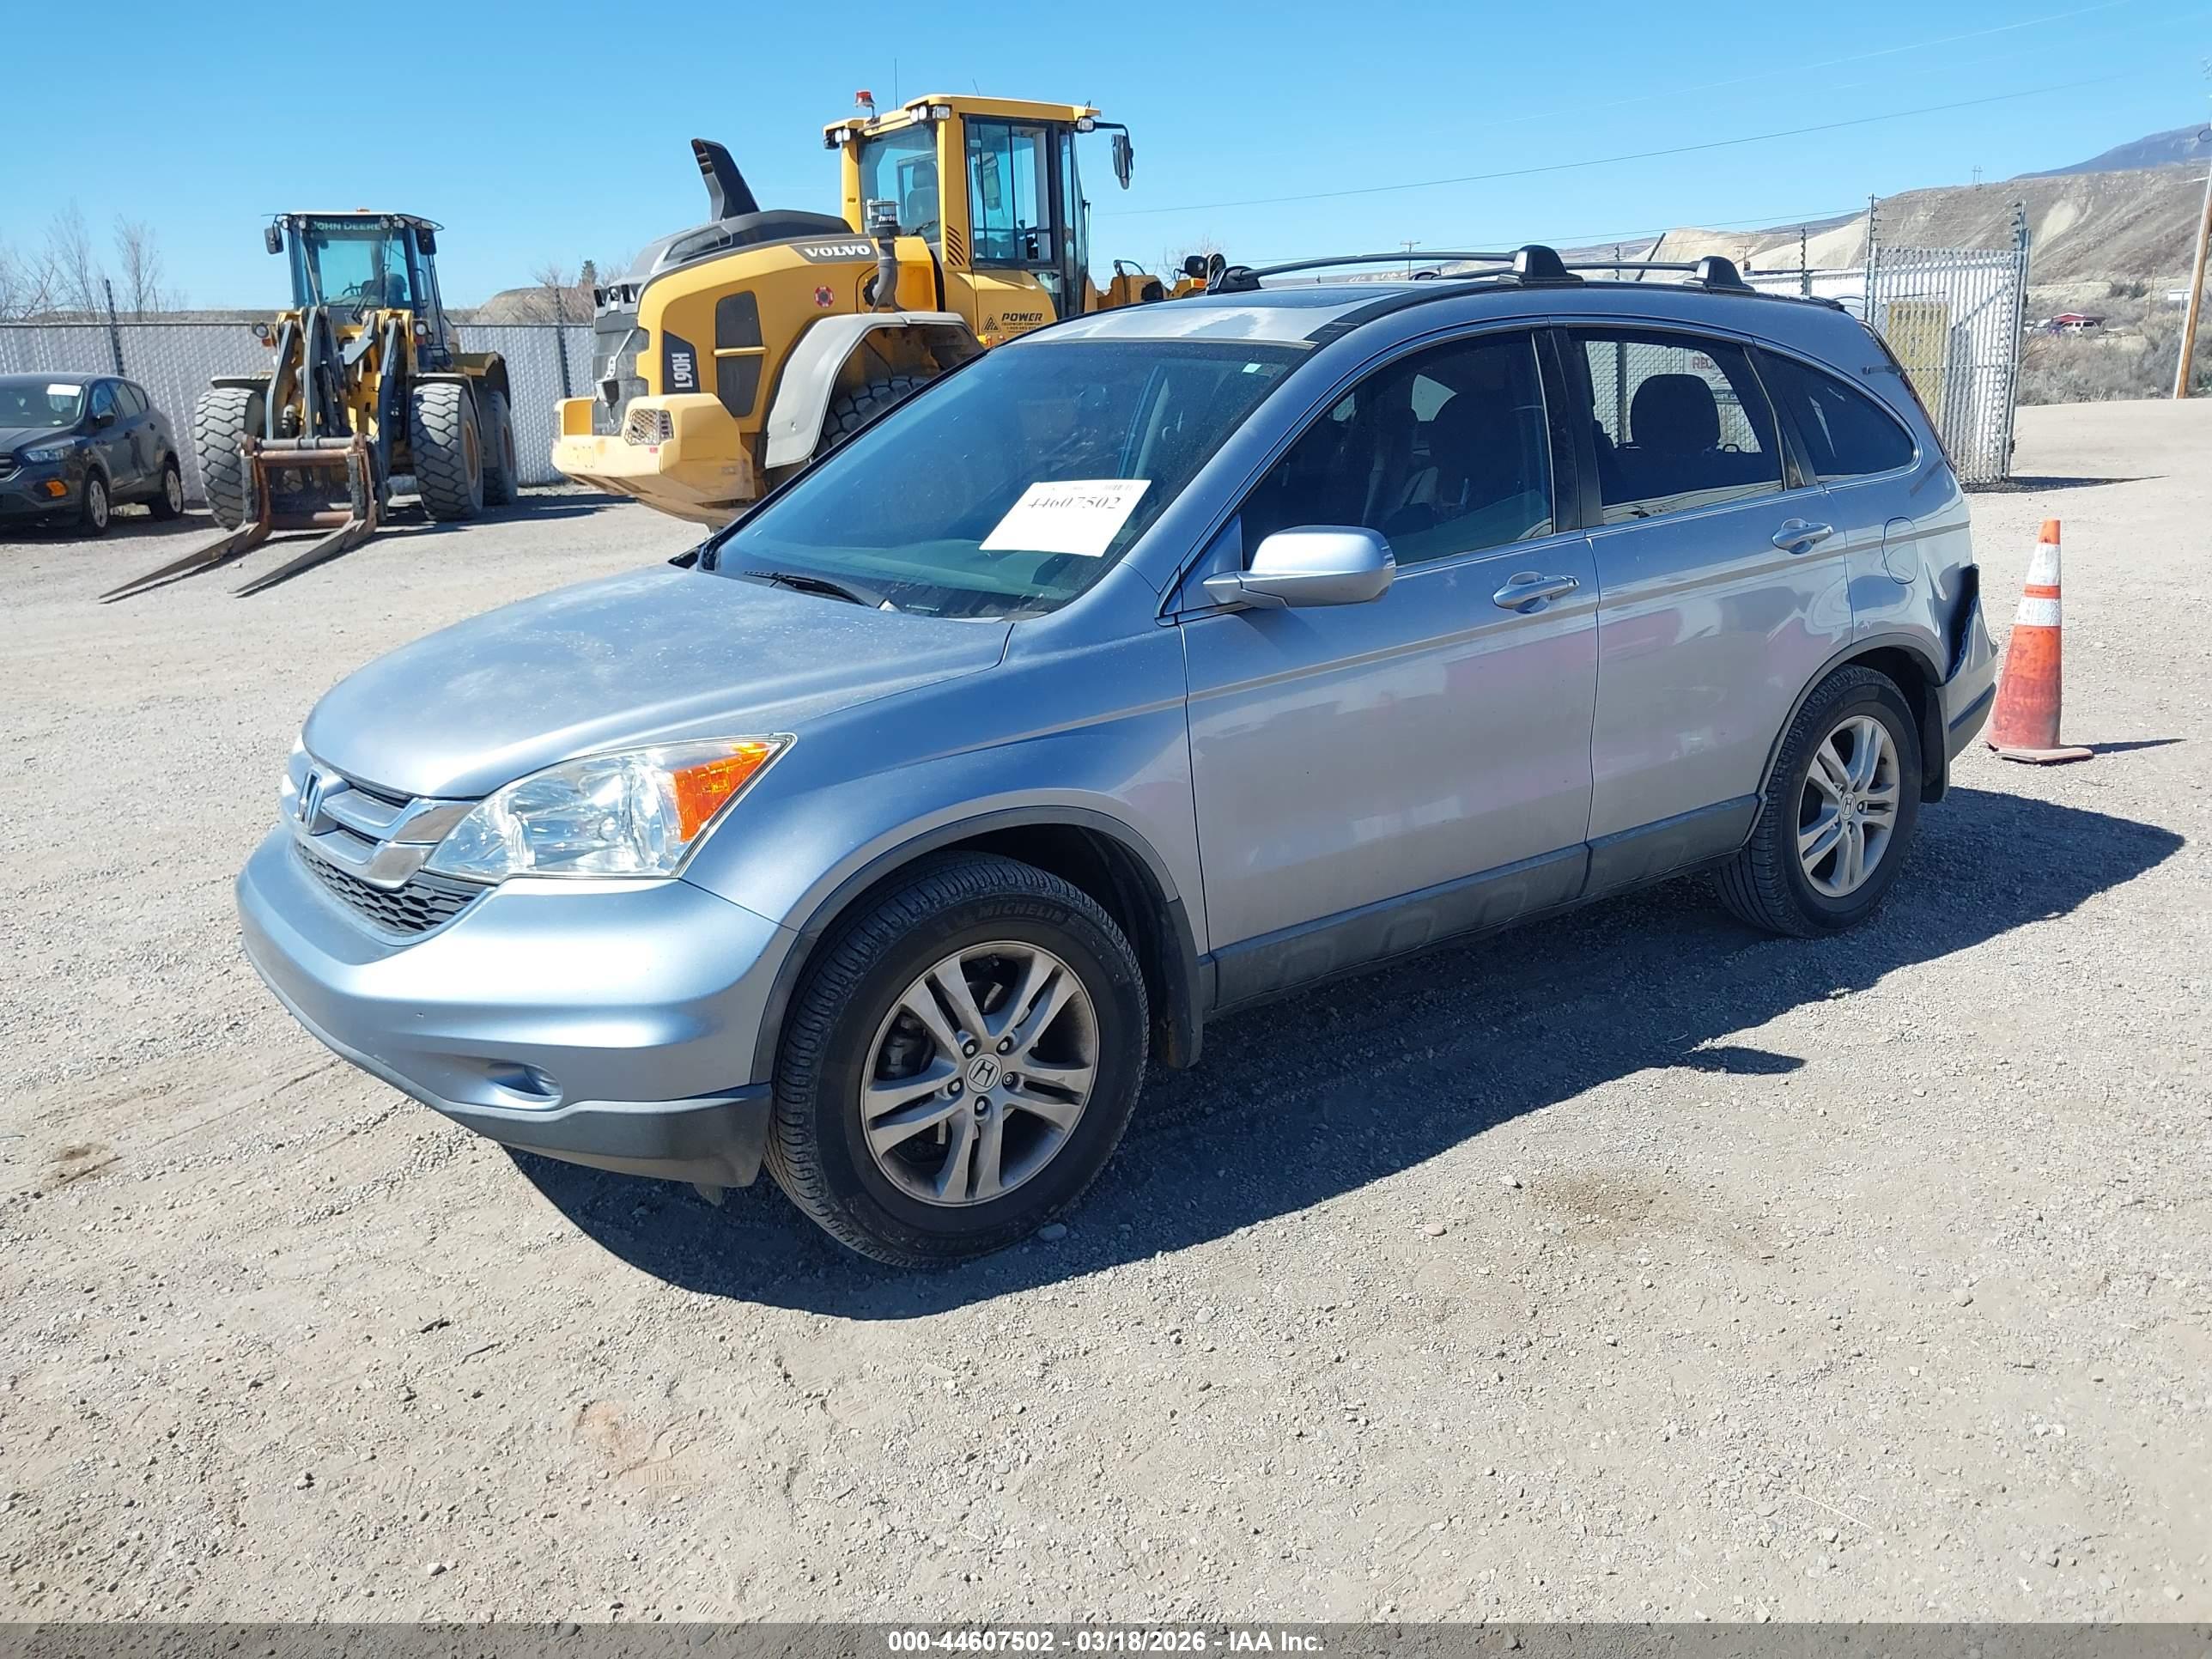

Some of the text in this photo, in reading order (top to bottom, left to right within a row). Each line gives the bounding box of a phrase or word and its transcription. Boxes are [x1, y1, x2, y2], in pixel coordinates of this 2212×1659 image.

[805, 246, 871, 257] VOLVO
[1001, 313, 1043, 322] POWER
[672, 353, 693, 388] L90H
[1029, 496, 1121, 509] 44607502
[978, 902, 1066, 921] MICHELIN
